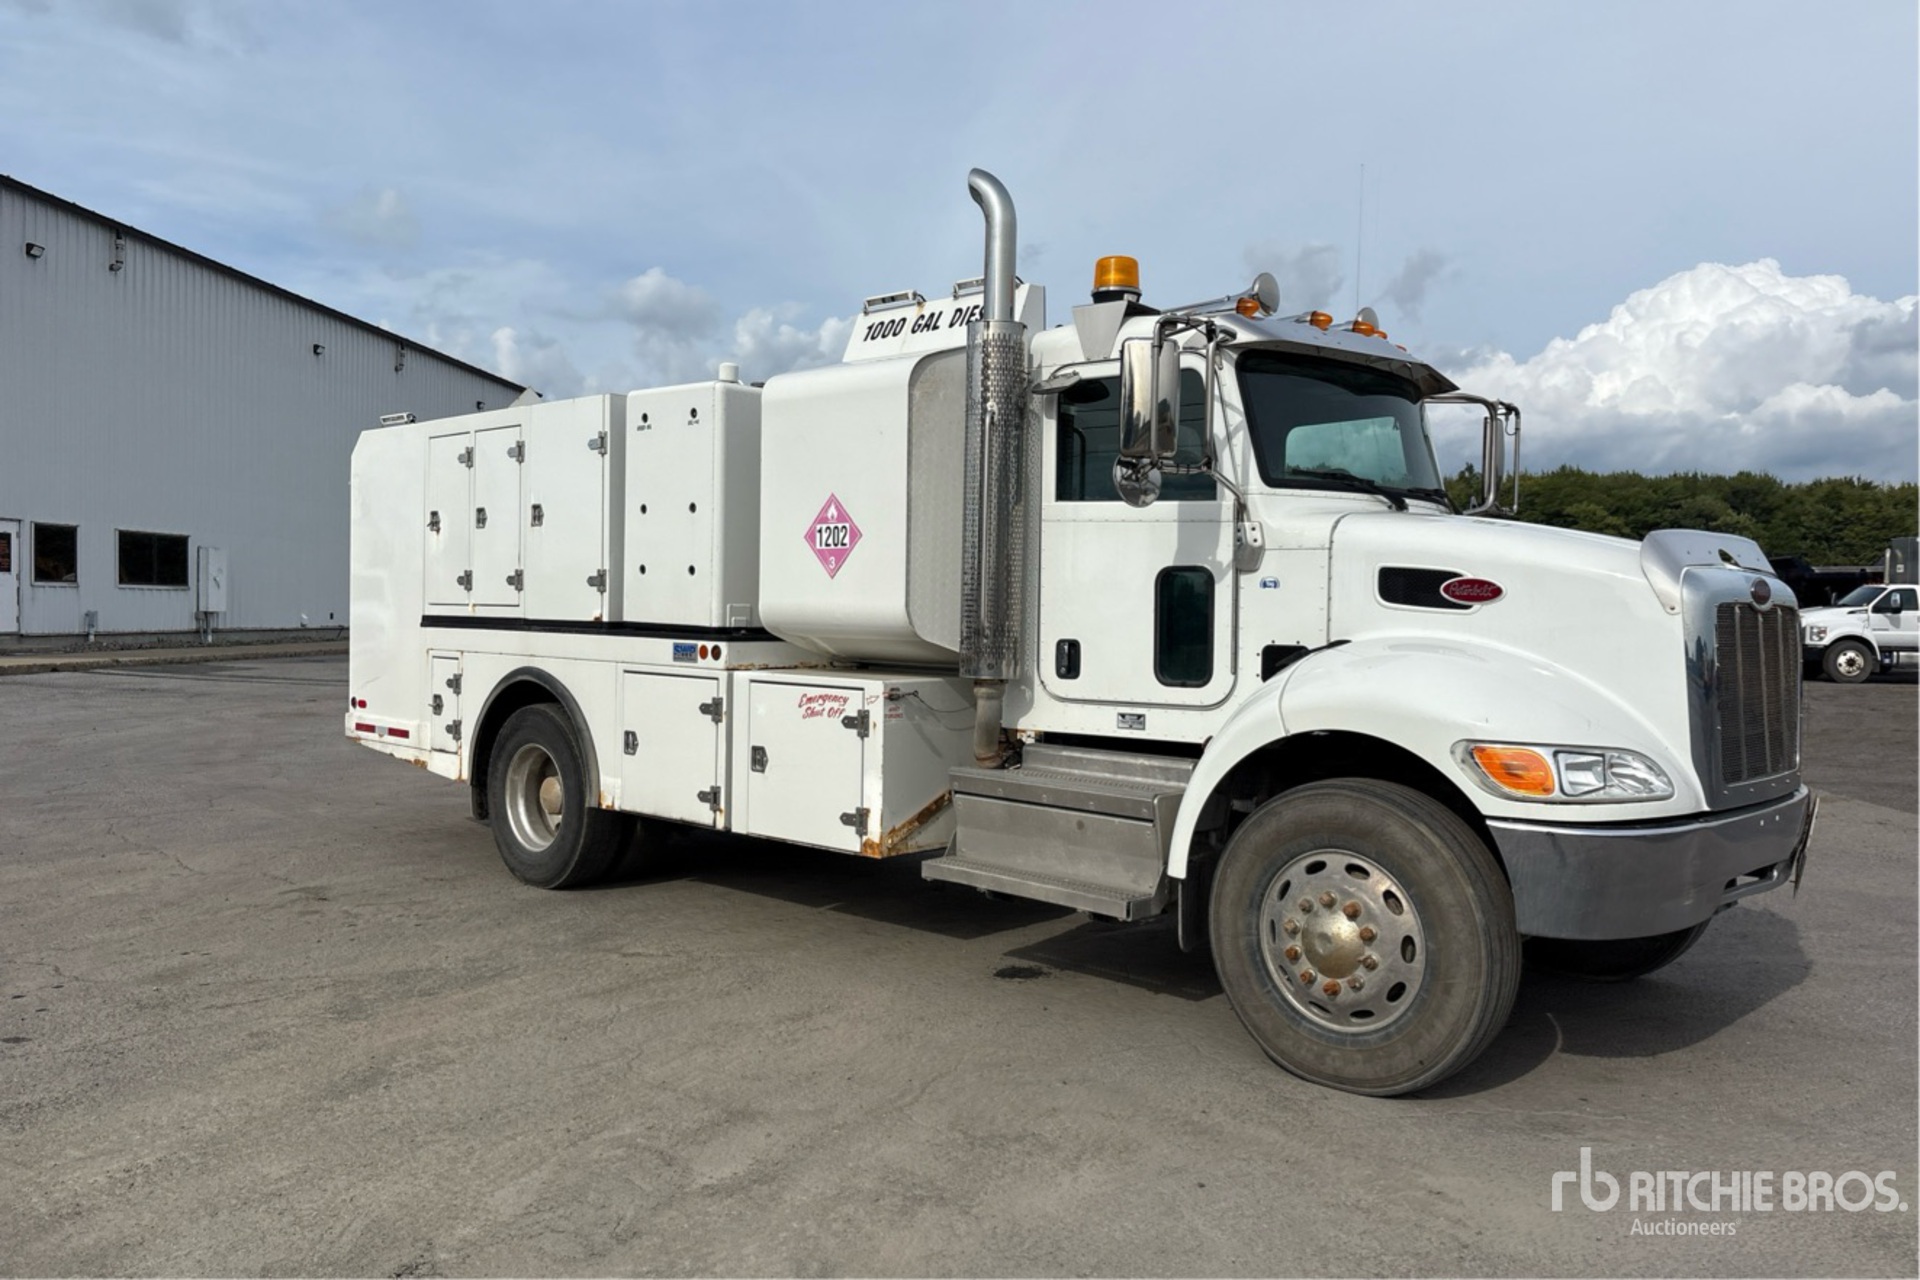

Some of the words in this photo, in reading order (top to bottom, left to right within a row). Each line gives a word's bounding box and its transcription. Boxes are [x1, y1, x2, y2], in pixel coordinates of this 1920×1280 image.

[863, 317, 907, 342] 1000
[910, 310, 944, 334] GAL
[817, 525, 848, 547] 1202
[829, 556, 836, 570] 3
[798, 693, 849, 708] Emergency
[802, 706, 825, 719] Shut
[827, 706, 846, 719] Off
